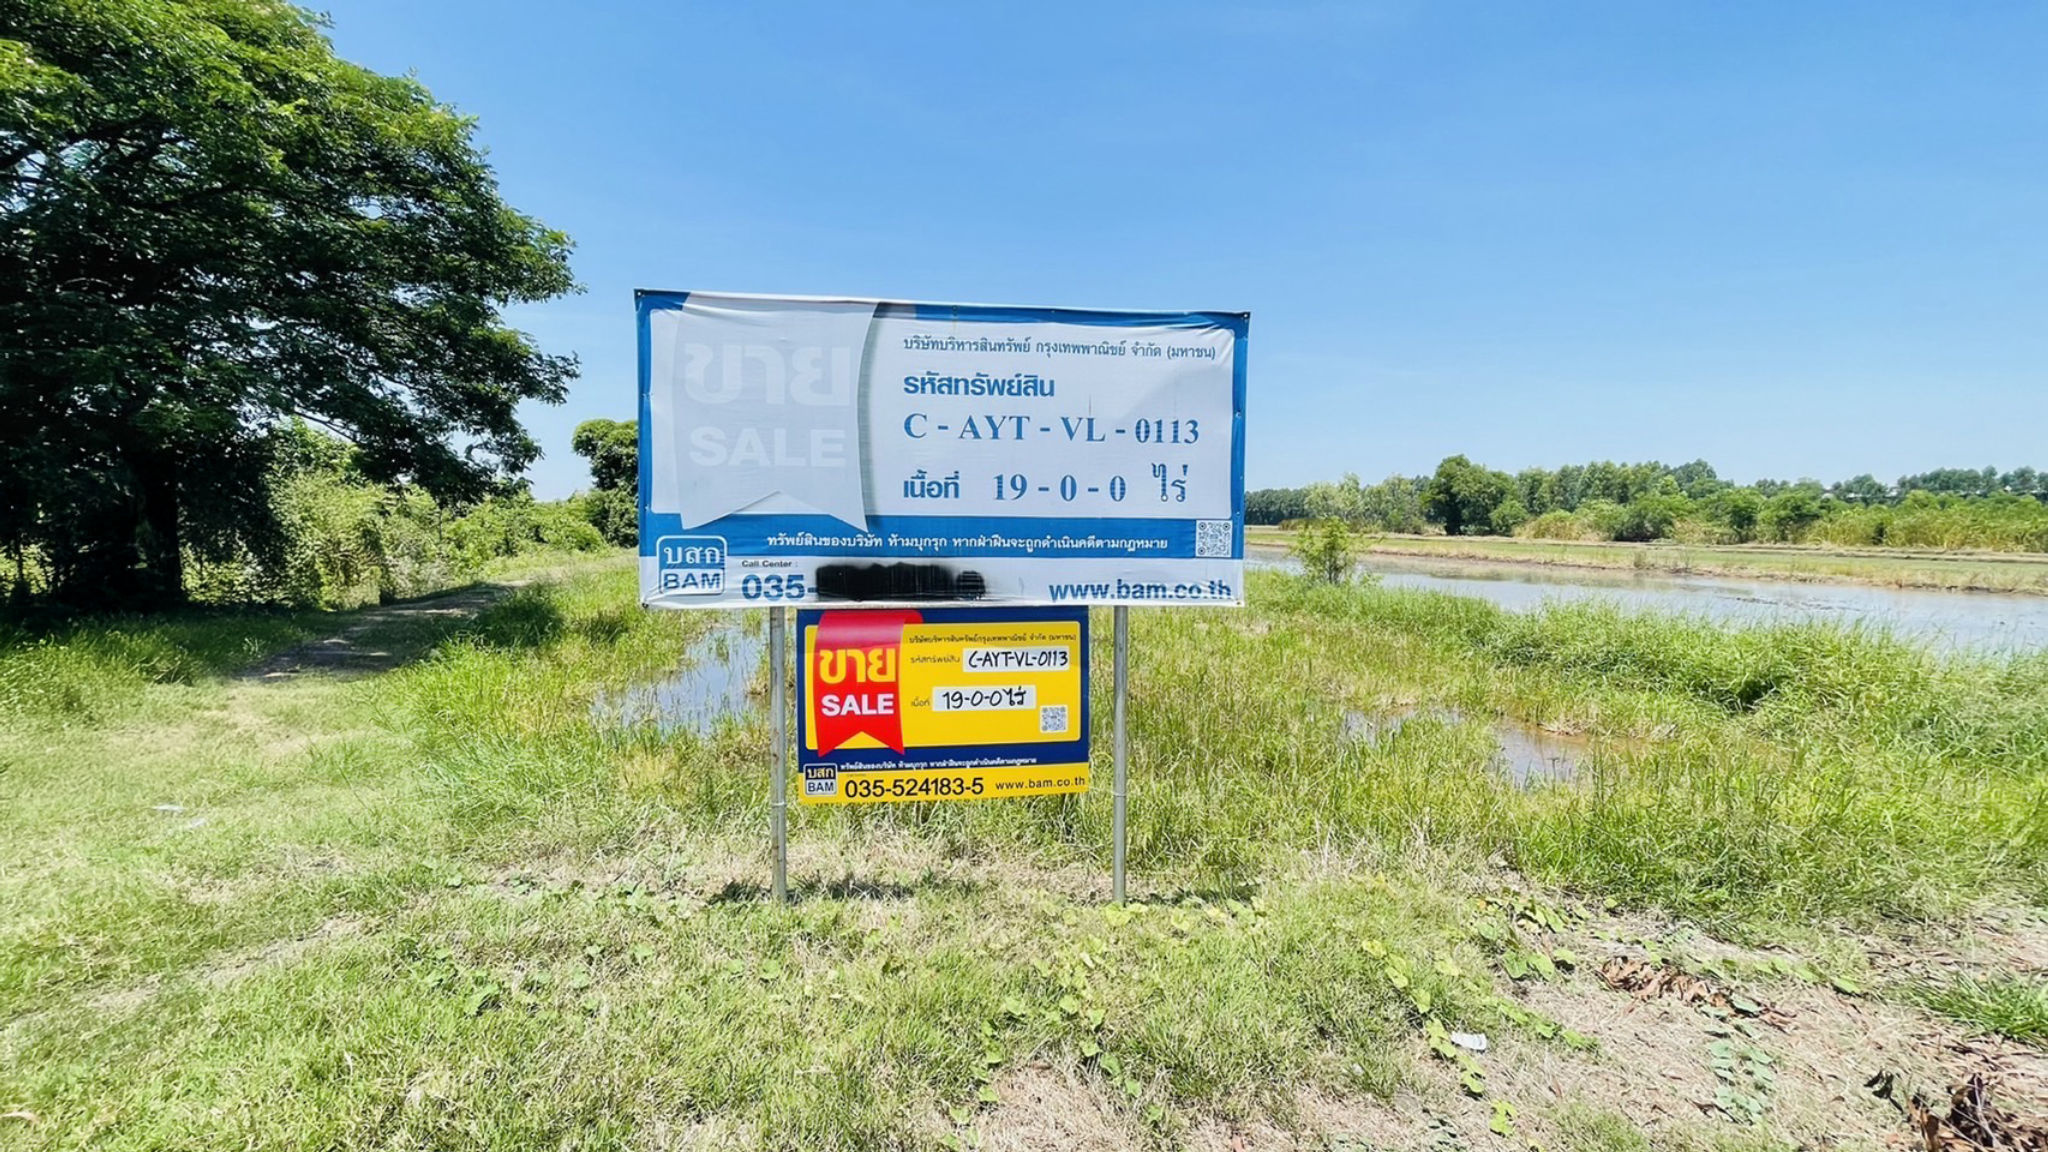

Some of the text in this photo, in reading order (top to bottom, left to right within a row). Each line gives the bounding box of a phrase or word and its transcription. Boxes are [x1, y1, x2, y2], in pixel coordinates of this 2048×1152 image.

[903, 336, 1217, 360] บริษัทบริหารสินทรัพย์ กรุงเทพพาณิชย์ จำกัด (มหาชน)
[684, 343, 851, 407] ขาย
[903, 371, 1055, 397] รหัสทรัพย์สิน
[903, 413, 928, 439] C
[957, 415, 1031, 441] AYT
[1060, 416, 1106, 442] VL
[1134, 417, 1200, 444] 0113
[689, 426, 847, 468] SALE
[903, 469, 960, 500] เนื้อที่
[992, 473, 1028, 501] 19
[1151, 462, 1189, 503] ไร่
[767, 532, 883, 548] ทรัพย์สินของบริษัท
[888, 533, 947, 551] ห้ามบุกรุก
[664, 545, 721, 565] บสก
[741, 560, 759, 568] Call
[762, 560, 793, 568] Center
[664, 572, 721, 590] BAM
[1048, 578, 1232, 602] www.bam.co.th
[819, 648, 896, 684] ขาย
[968, 650, 1069, 668] C-AYT-VL-0113
[821, 693, 894, 717] SALE
[807, 767, 835, 779] บสก
[995, 776, 1086, 790] www.bam.co.th
[807, 781, 834, 793] BAM
[845, 777, 984, 798] 035-524183-5
